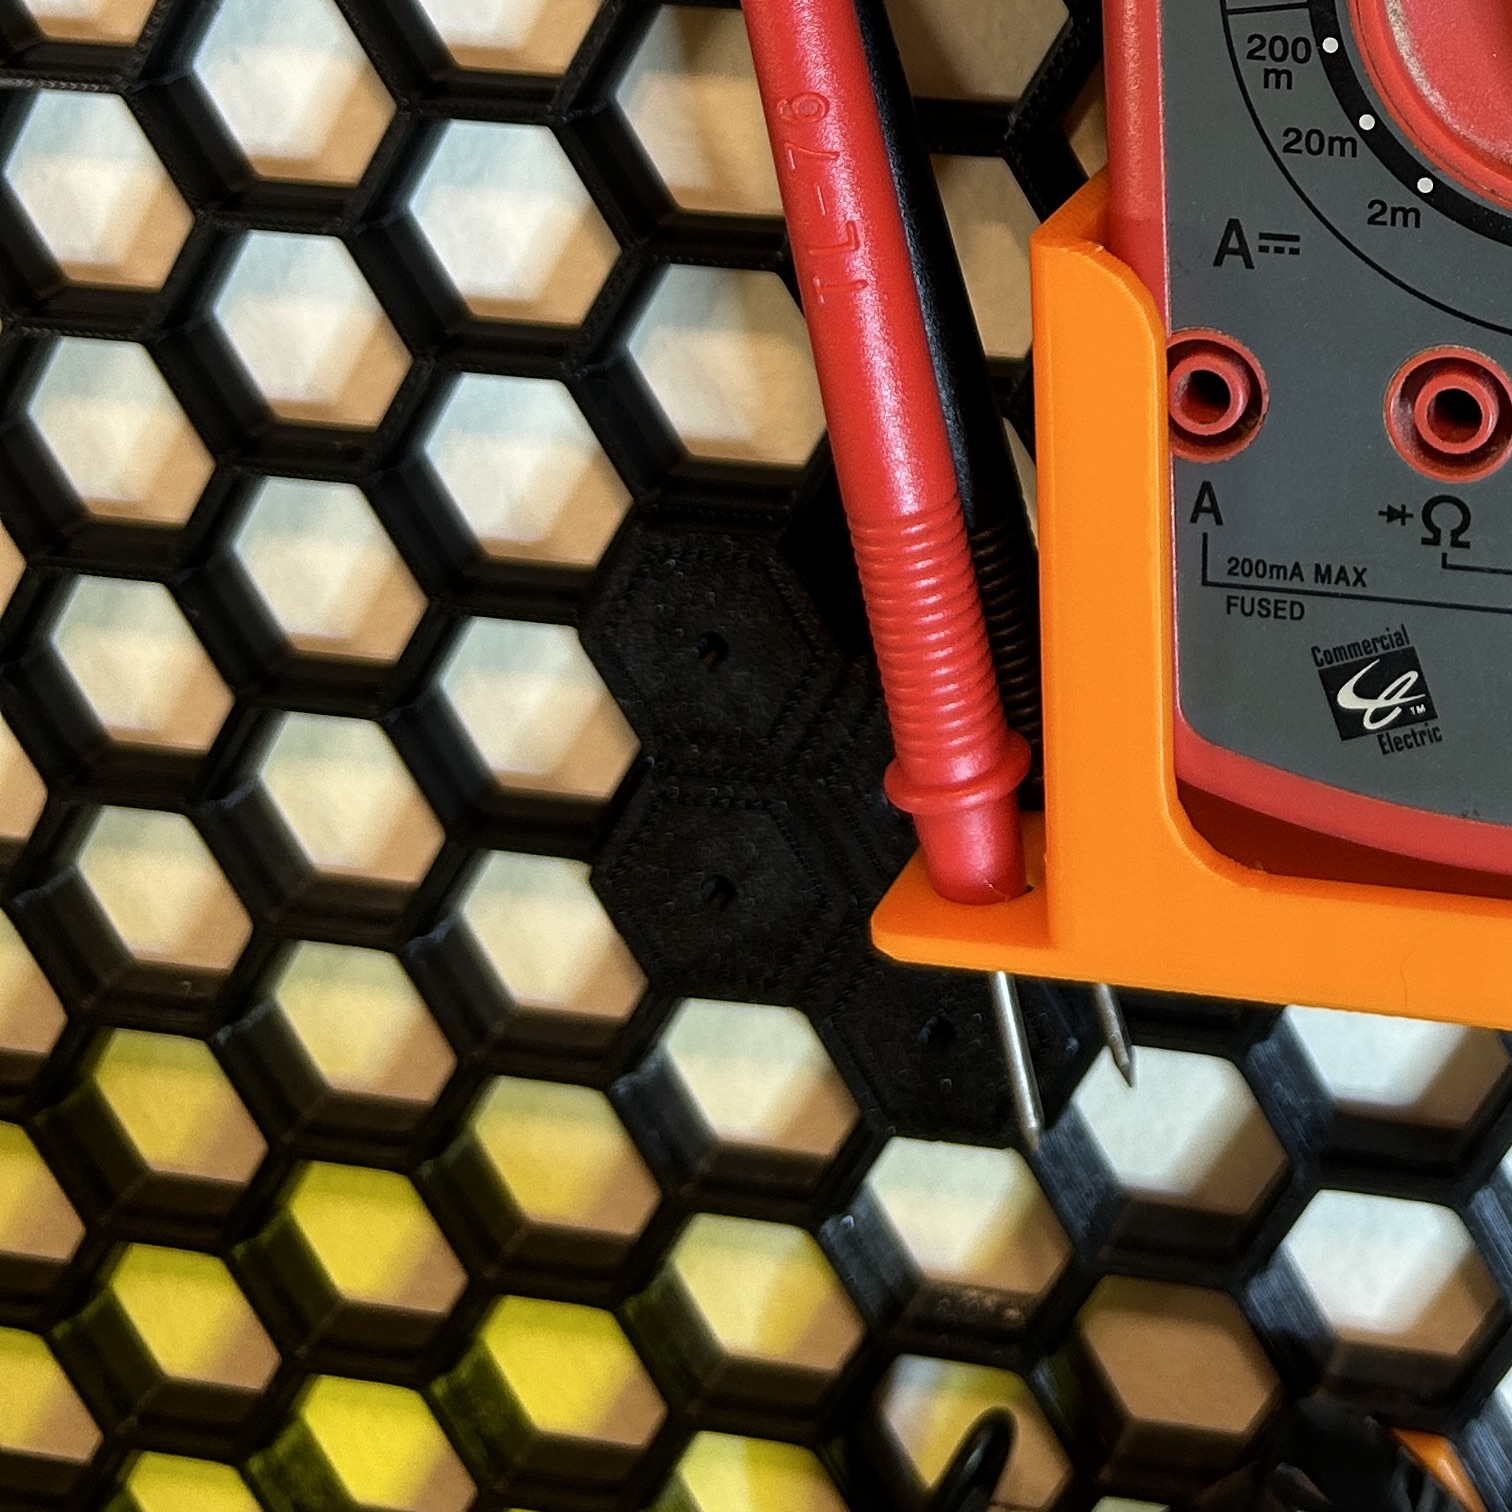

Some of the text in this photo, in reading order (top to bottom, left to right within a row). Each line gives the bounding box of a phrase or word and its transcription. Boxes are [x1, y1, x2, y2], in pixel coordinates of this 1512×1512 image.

[1246, 34, 1312, 63] 200
[1263, 67, 1293, 90] m
[1282, 128, 1358, 157] 20m
[1367, 199, 1421, 228] 2m
[1190, 481, 1223, 526] A
[1226, 556, 1367, 588] 200mA MAX
[1225, 595, 1306, 621] FUSED
[1311, 623, 1411, 669] Commercial
[1377, 721, 1443, 756] Electric
